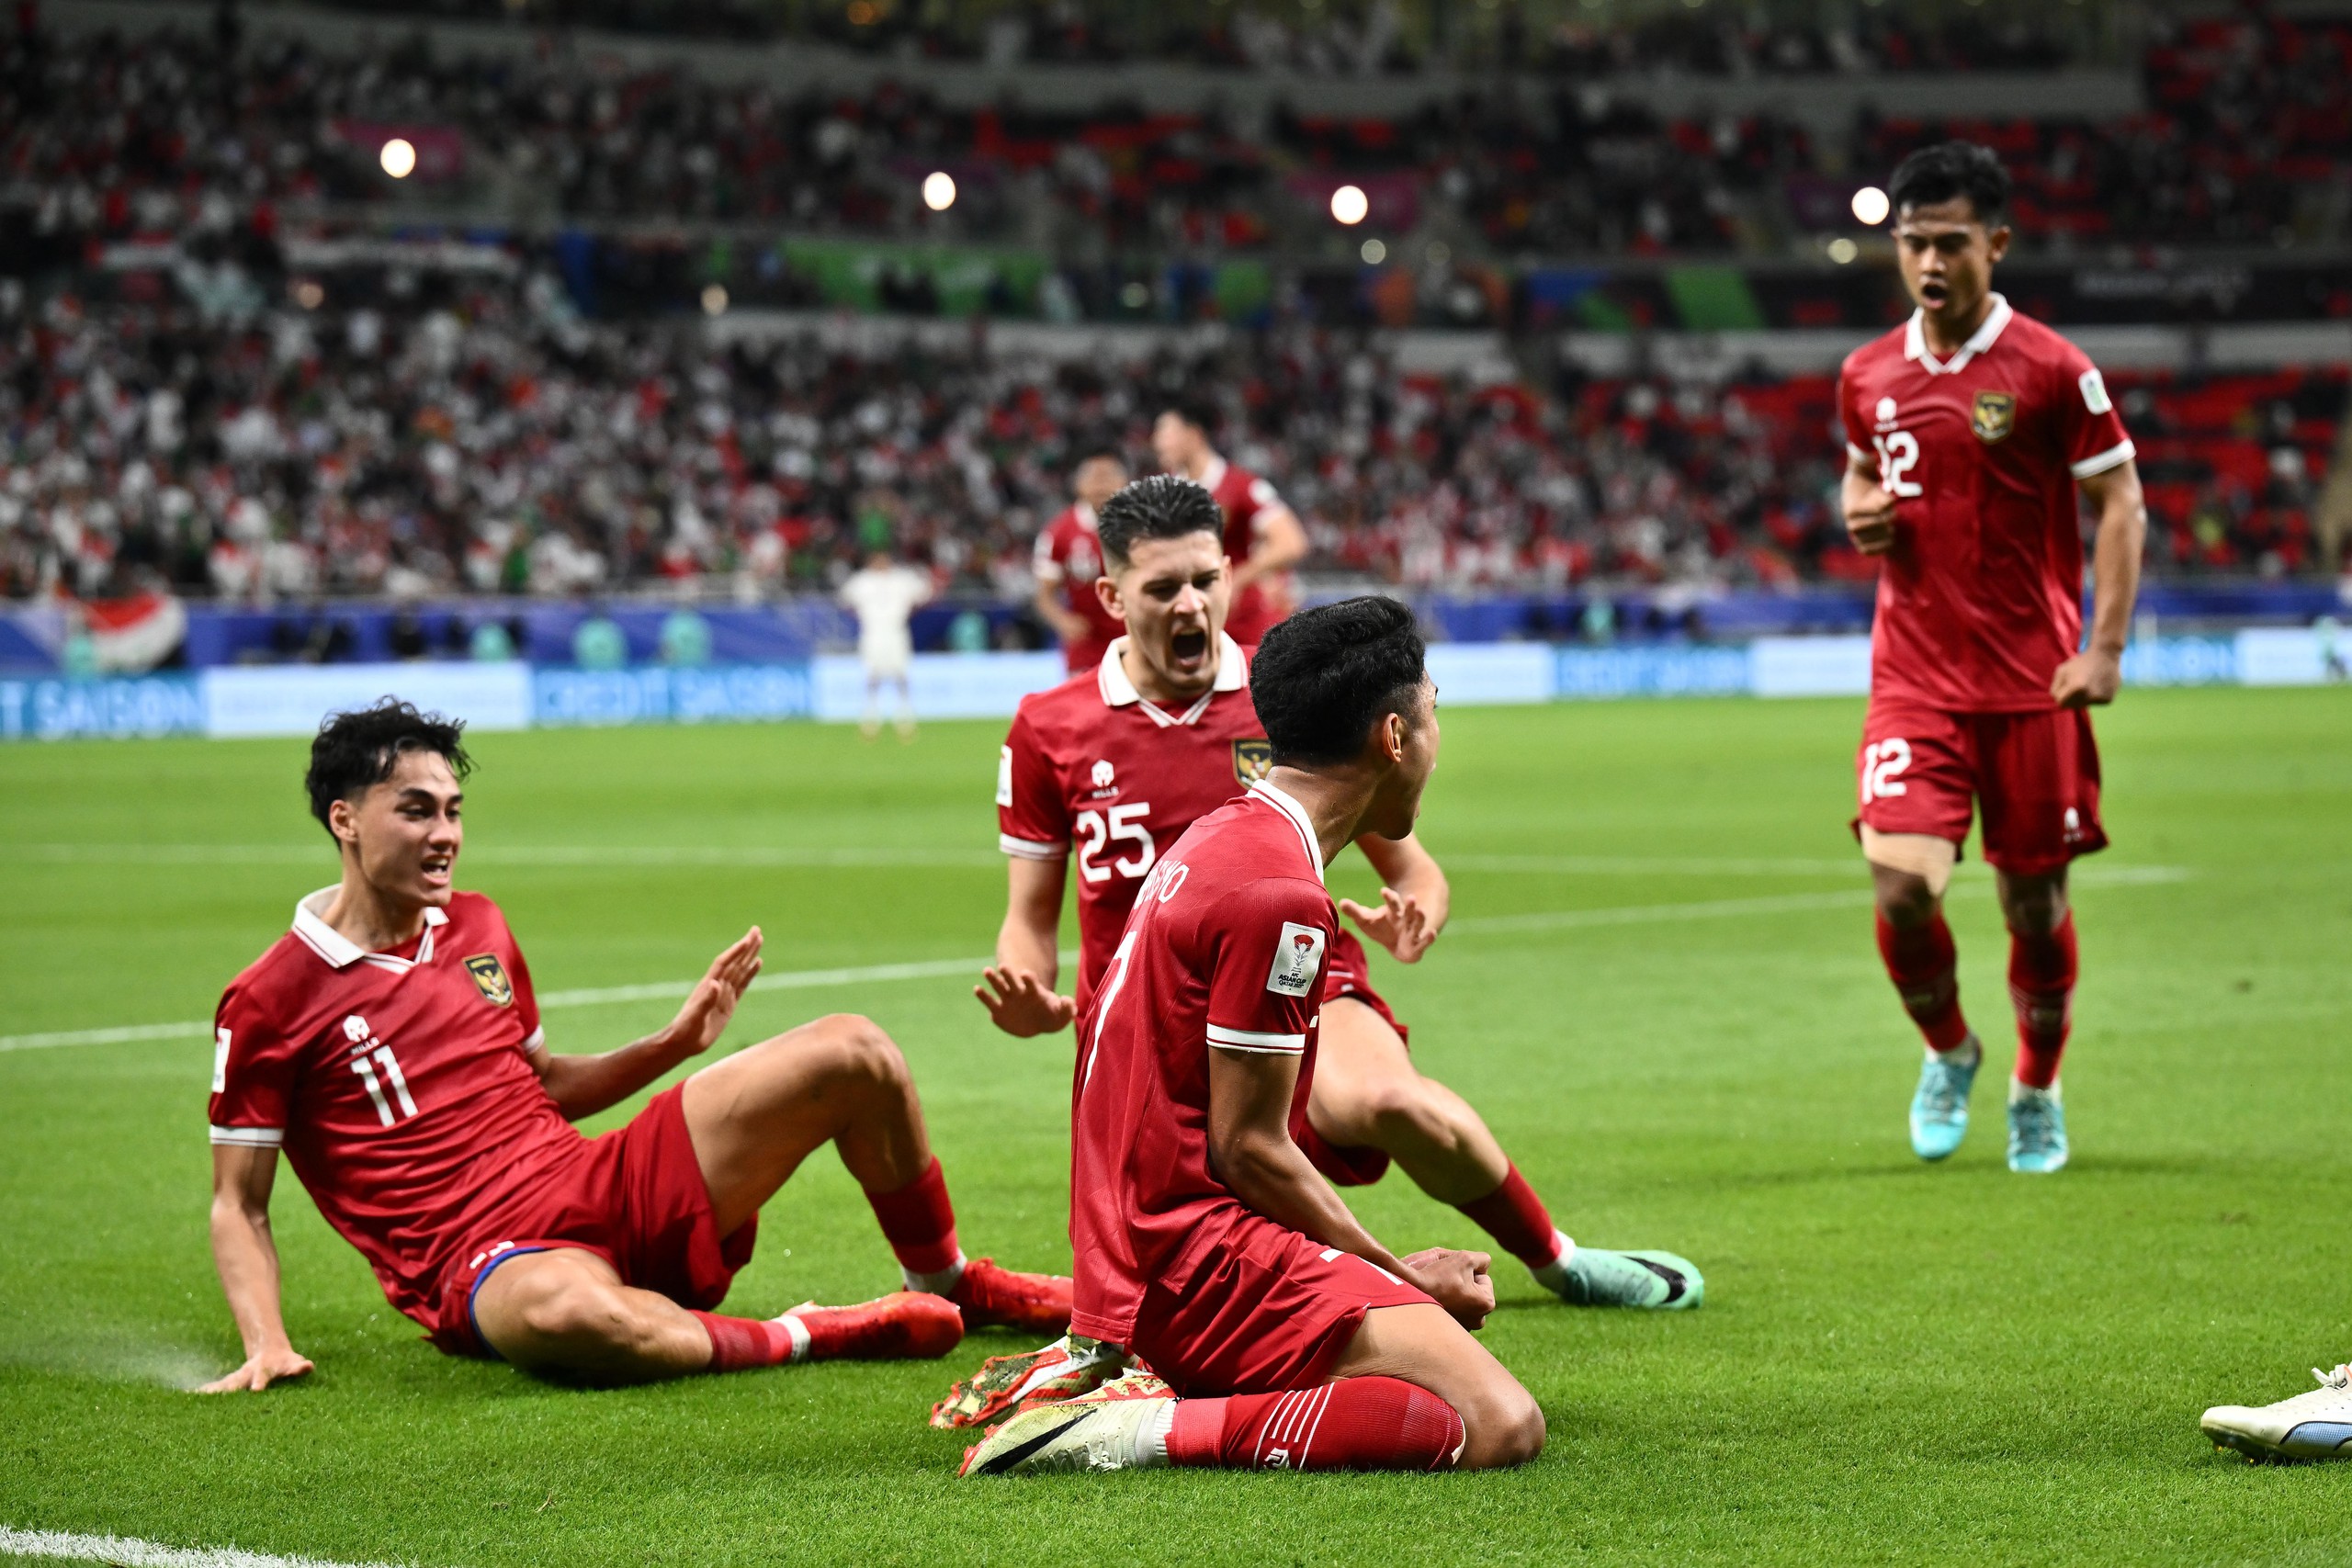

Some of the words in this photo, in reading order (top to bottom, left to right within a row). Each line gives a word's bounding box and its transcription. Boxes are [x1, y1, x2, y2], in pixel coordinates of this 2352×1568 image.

[1872, 431, 1923, 497] 12
[1862, 738, 1912, 805] 12
[1077, 802, 1156, 883] 25
[1278, 975, 1296, 983] ASIAN
[351, 1044, 419, 1127] 11
